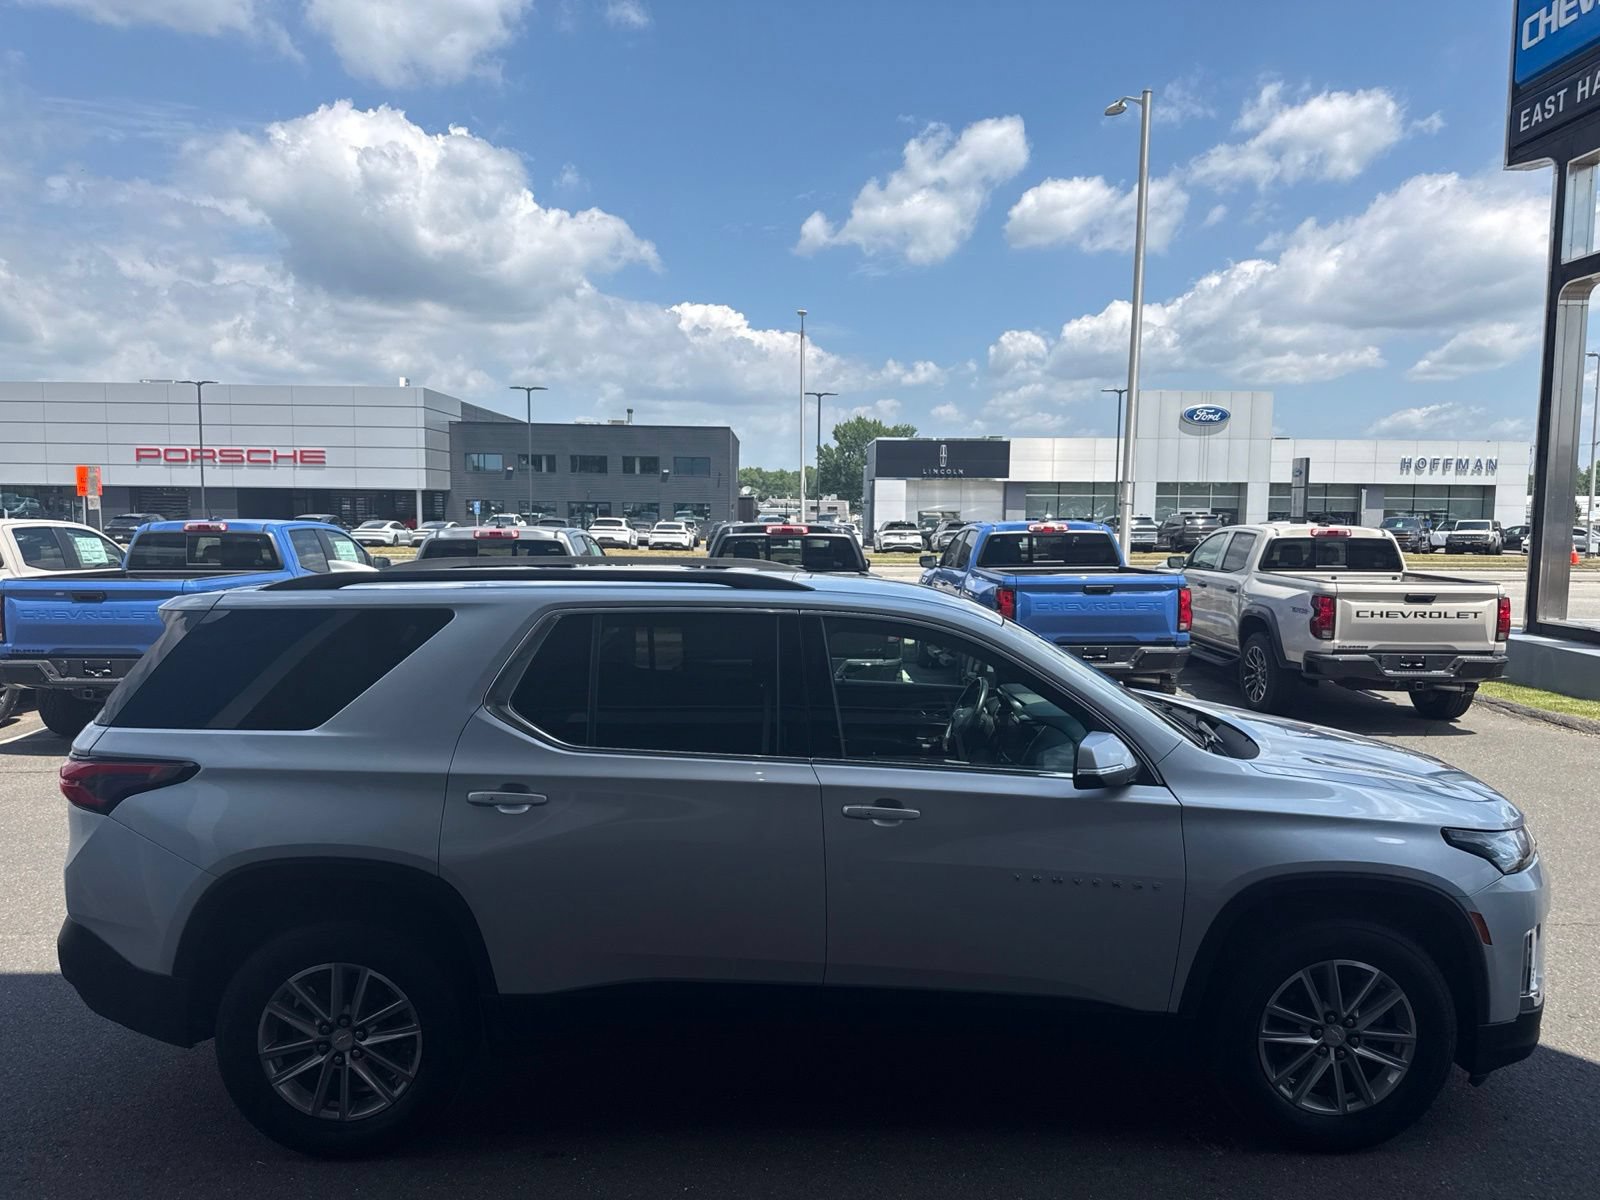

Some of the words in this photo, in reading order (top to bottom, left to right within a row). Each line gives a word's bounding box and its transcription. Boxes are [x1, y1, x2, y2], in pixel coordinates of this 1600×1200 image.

[1519, 87, 1568, 133] EAST
[1193, 408, 1222, 421] Ford
[135, 447, 326, 465] PORSCHE
[1401, 457, 1498, 471] HOFFMAN
[1034, 601, 1163, 612] CHEVROLET
[1355, 610, 1483, 620] CHEVROLET
